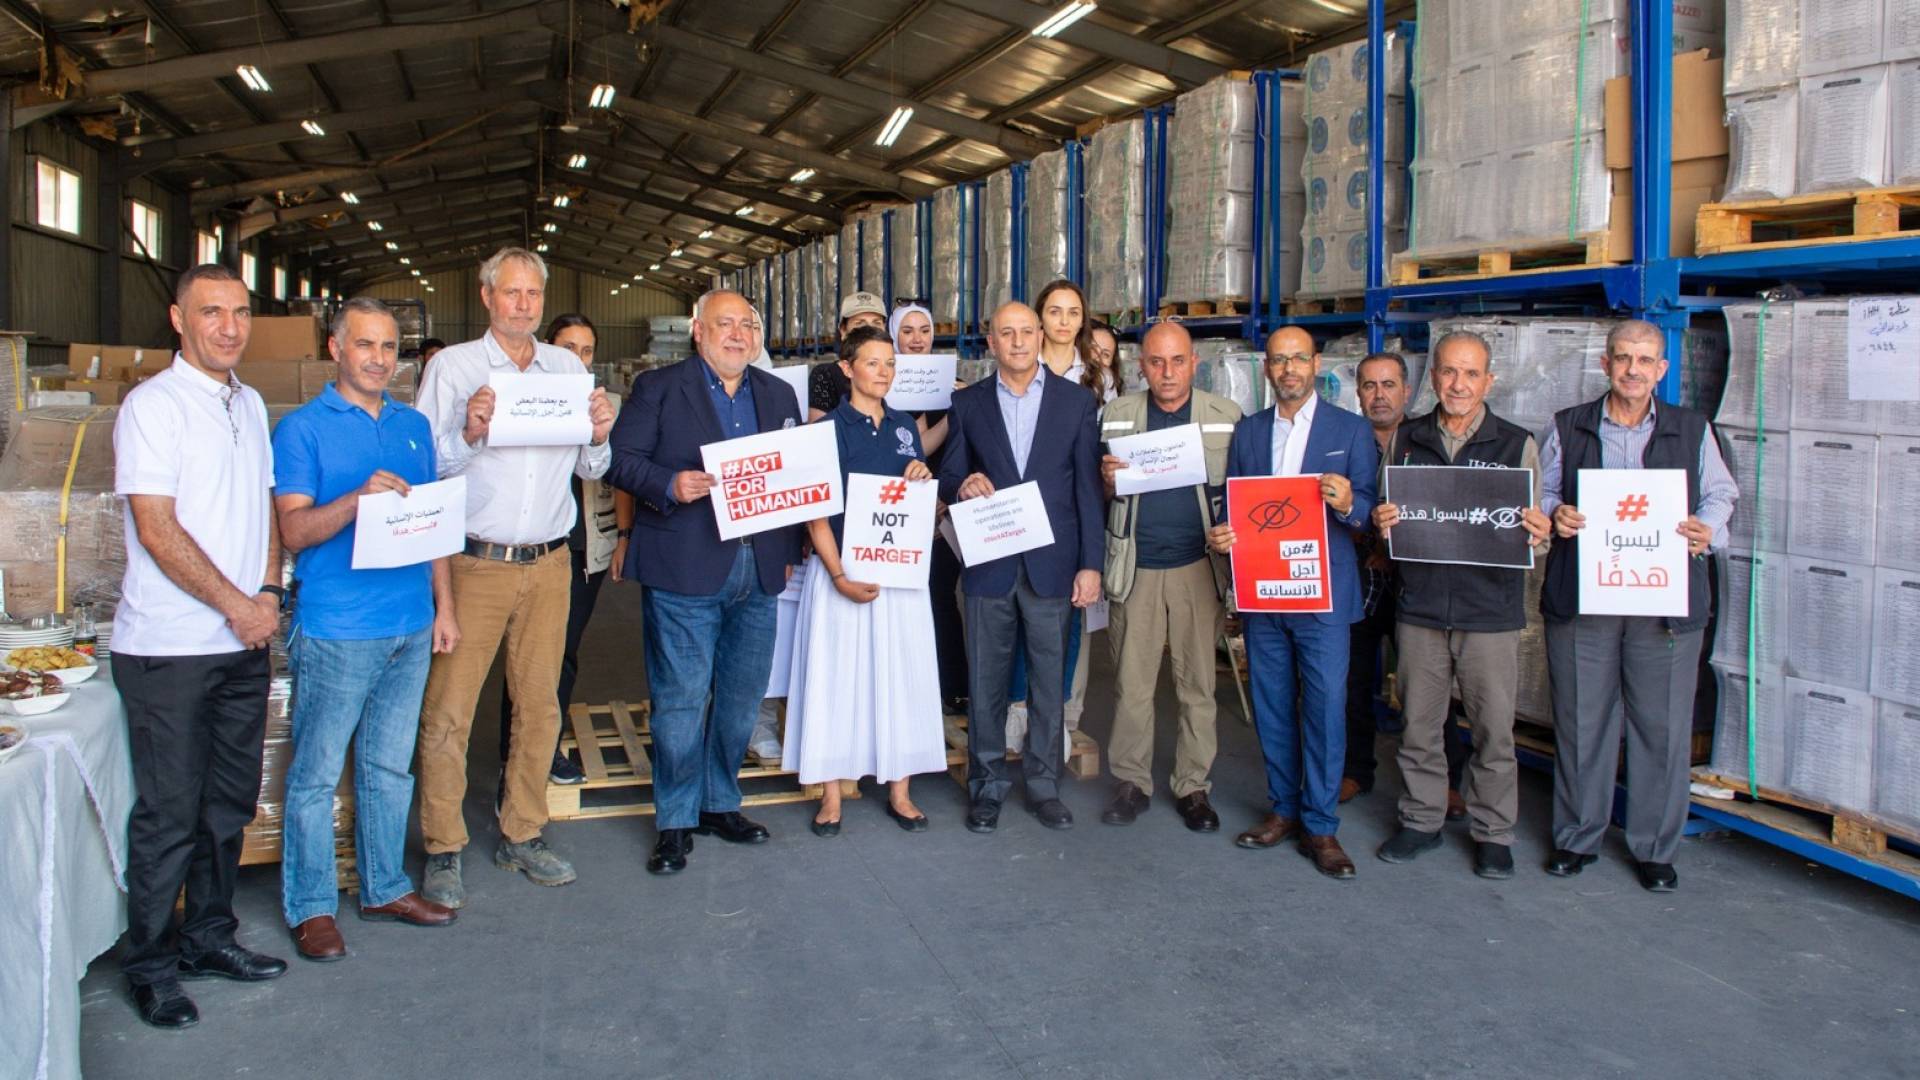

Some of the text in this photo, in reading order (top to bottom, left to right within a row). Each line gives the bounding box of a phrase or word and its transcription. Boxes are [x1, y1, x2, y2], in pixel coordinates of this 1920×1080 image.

[723, 453, 779, 479] #ACT
[724, 477, 765, 499] FOR
[879, 480, 907, 505] #
[729, 484, 830, 520] HUMANITY
[1615, 494, 1649, 522] #
[872, 512, 909, 528] NOT
[881, 530, 894, 545] A
[1605, 529, 1660, 552] ليسوا
[851, 547, 923, 565] TARGET
[1282, 543, 1314, 558] #من
[1292, 561, 1315, 579] أجل
[1597, 554, 1669, 588] هدفًا
